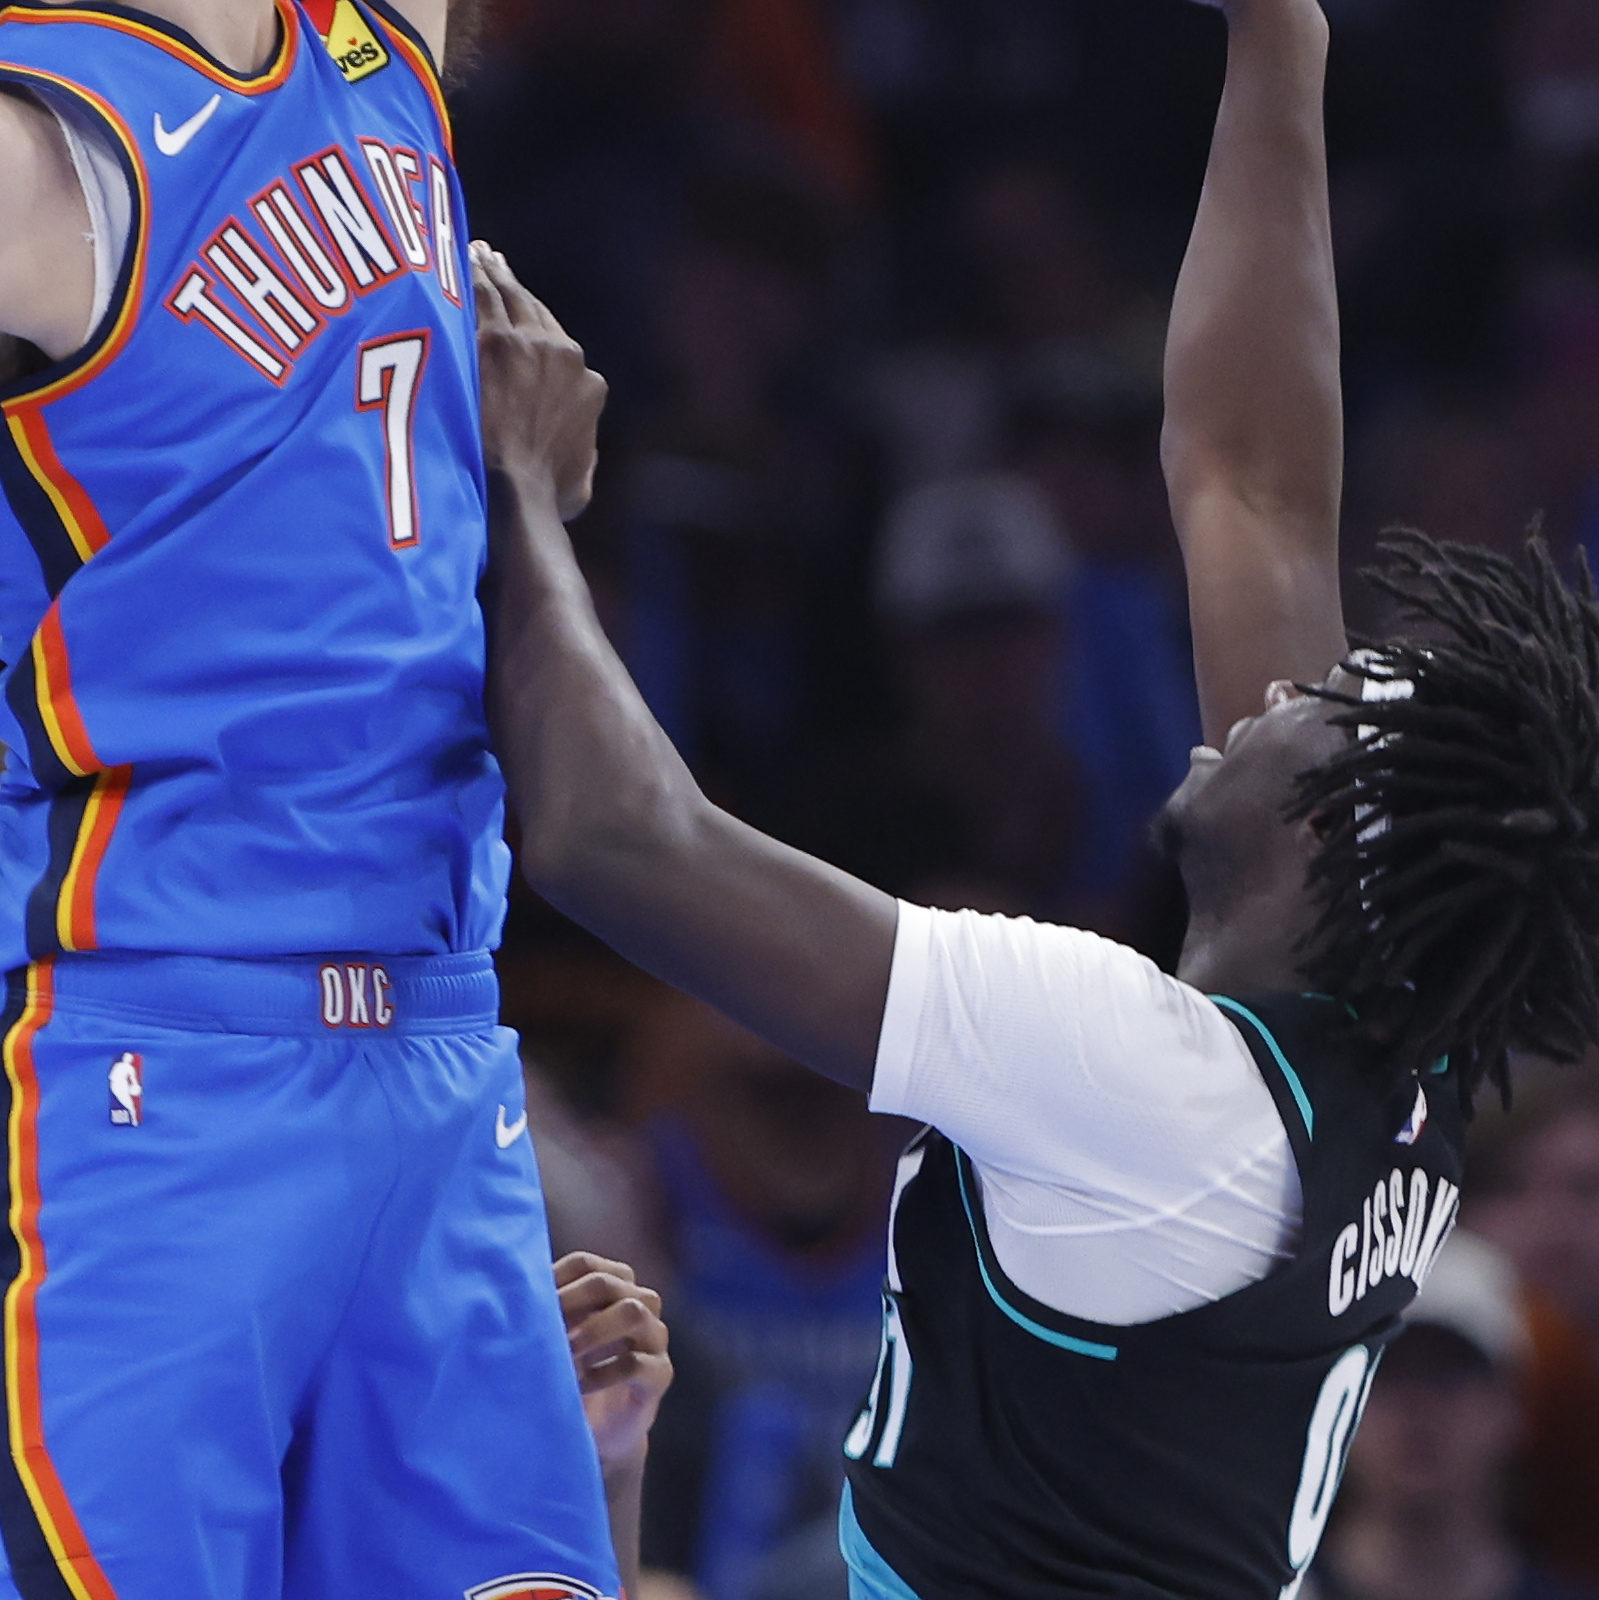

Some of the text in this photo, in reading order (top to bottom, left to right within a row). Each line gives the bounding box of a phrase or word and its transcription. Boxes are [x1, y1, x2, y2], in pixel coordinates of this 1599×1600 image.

[355, 329, 431, 551] 7
[319, 962, 395, 1030] OKC
[1328, 1166, 1460, 1318] CISSOK
